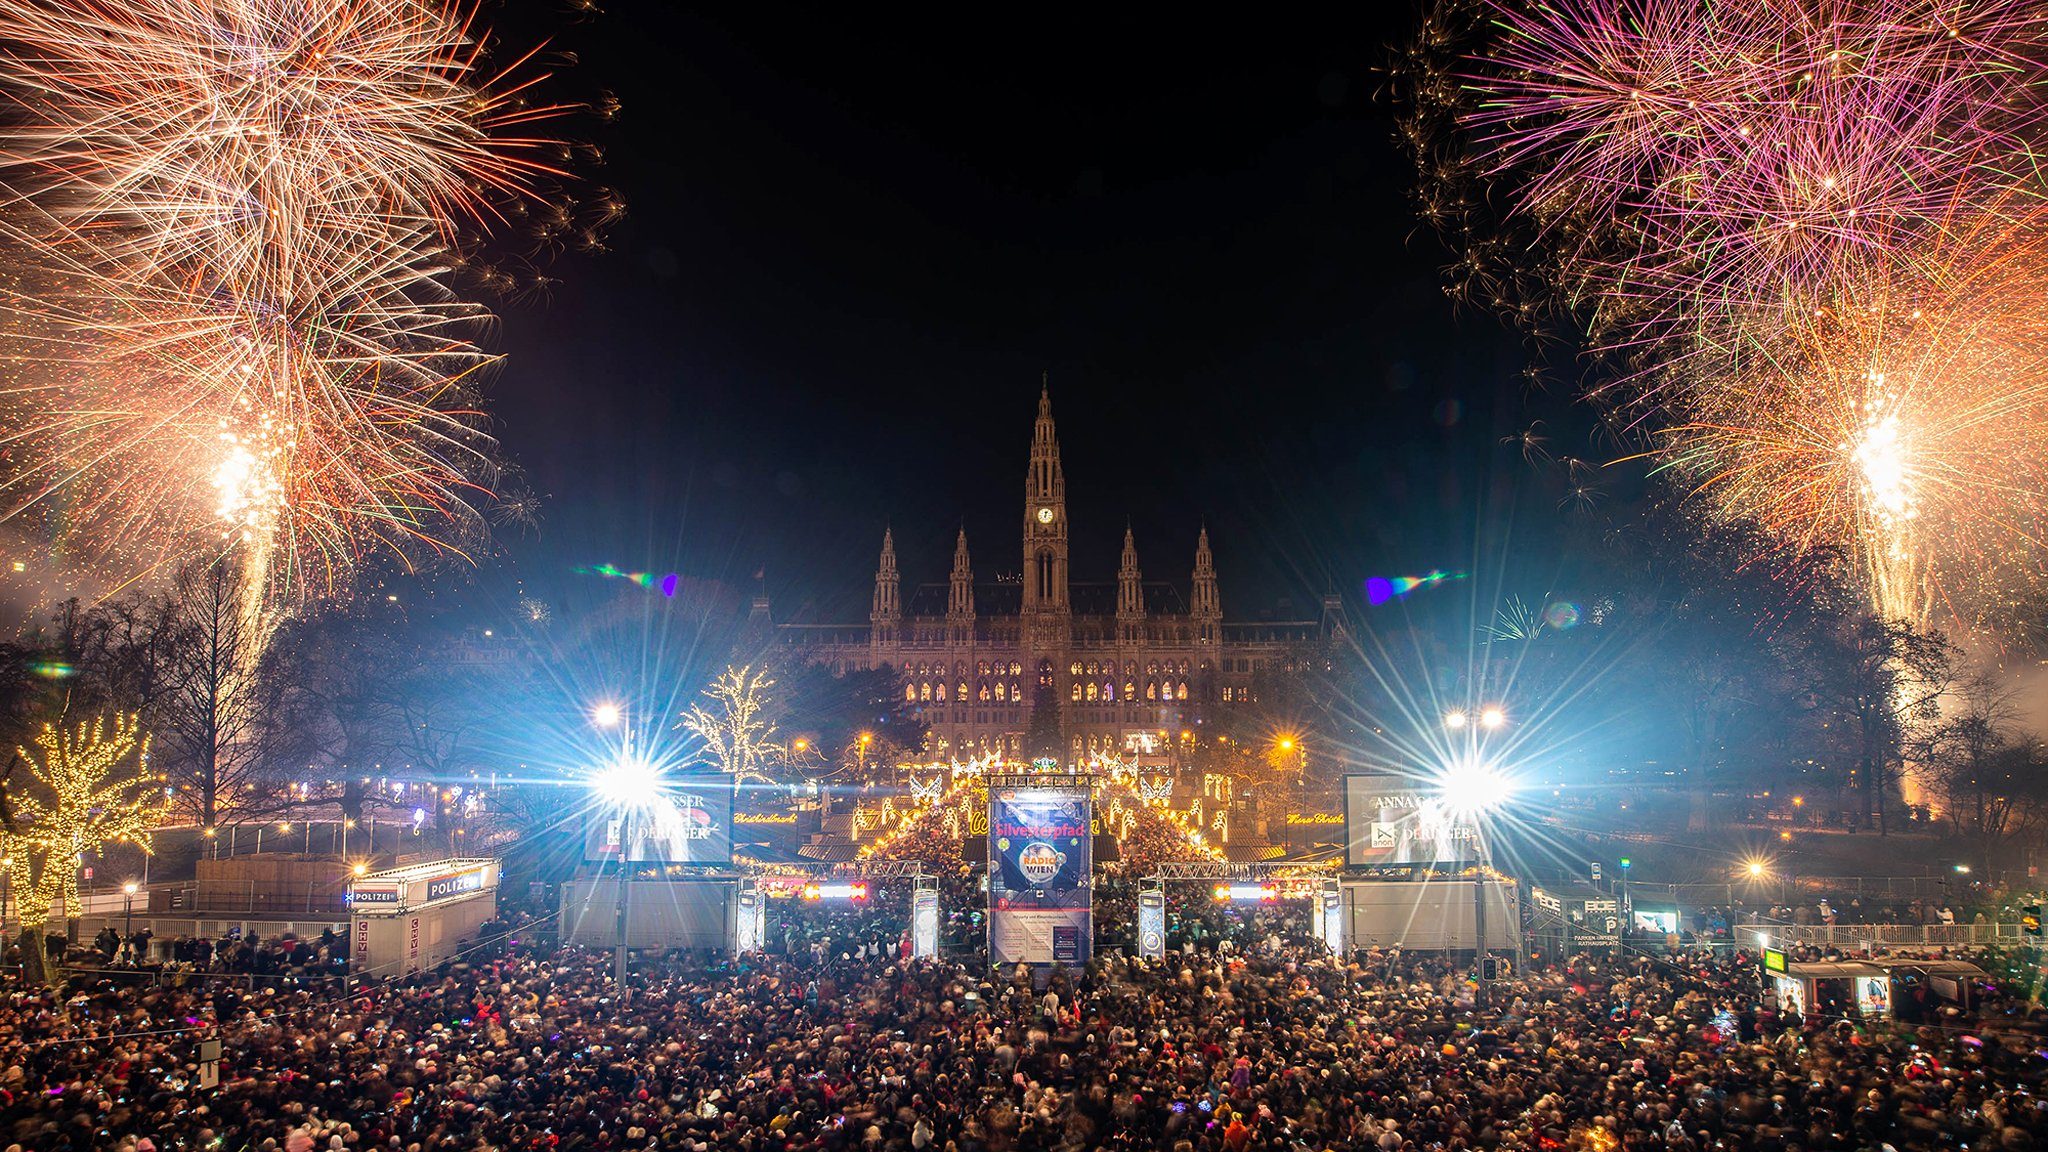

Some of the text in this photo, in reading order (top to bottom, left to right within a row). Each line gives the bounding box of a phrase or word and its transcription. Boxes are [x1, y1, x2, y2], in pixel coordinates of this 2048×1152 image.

[1375, 797, 1415, 809] ANNA
[640, 827, 709, 840] DERIGER
[995, 823, 1085, 840] Silvesterpfad
[1403, 827, 1472, 840] DERIGER
[1023, 857, 1057, 865] RADIO
[1026, 866, 1054, 874] WIEN
